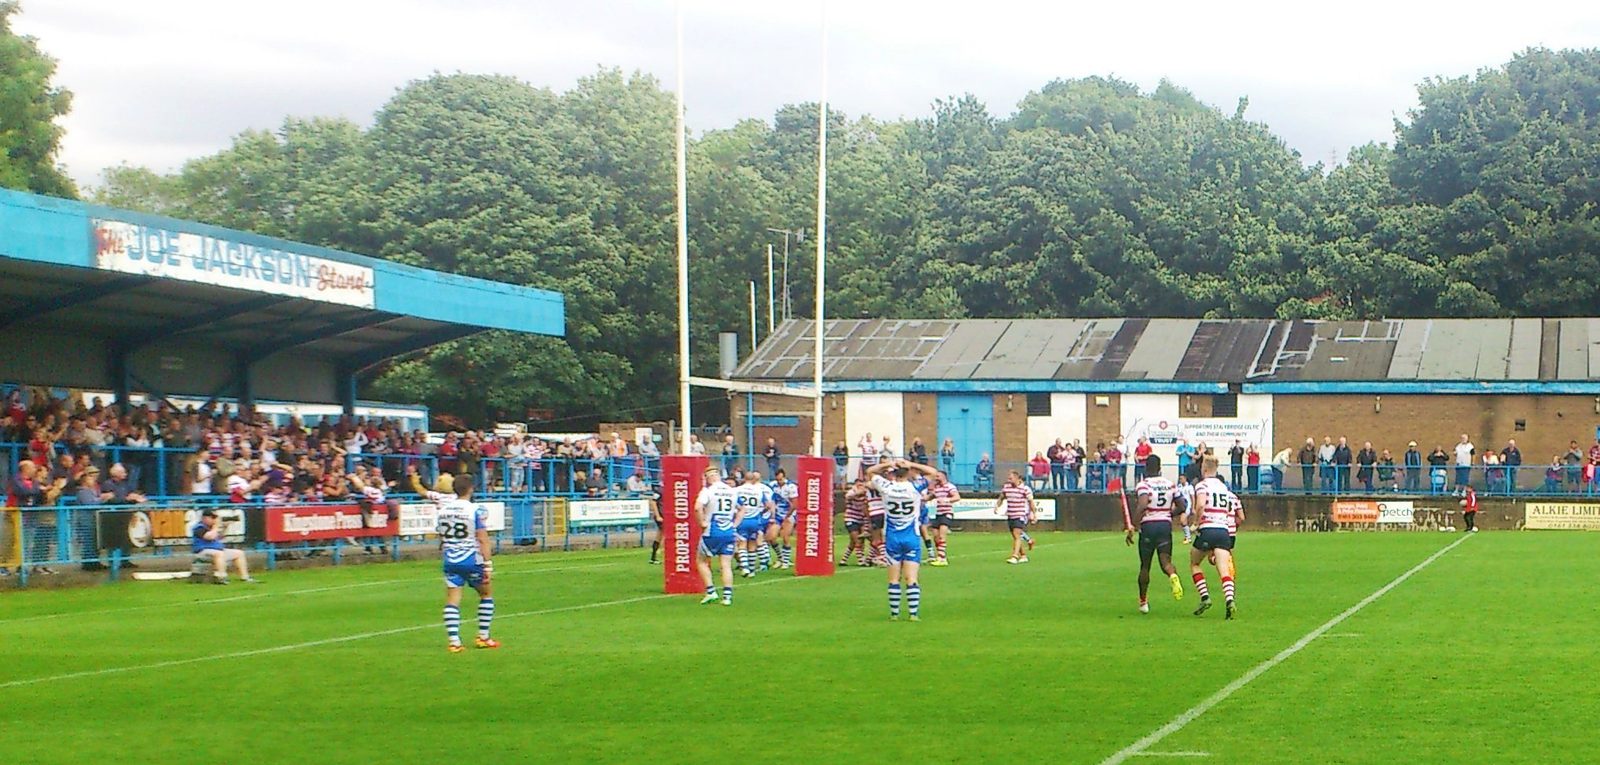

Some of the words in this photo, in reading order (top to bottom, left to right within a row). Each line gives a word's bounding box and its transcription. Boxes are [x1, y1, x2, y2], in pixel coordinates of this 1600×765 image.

[127, 225, 181, 267] JOE
[192, 236, 311, 289] JACKSON
[317, 264, 364, 294] Stand
[674, 479, 689, 519] CIDER
[807, 477, 820, 512] CIDER
[1157, 492, 1167, 507] 5
[1212, 492, 1228, 508] 15
[717, 498, 733, 512] 13
[887, 501, 914, 515] 25
[1532, 505, 1569, 515] ALKIE
[440, 522, 469, 539] 28
[805, 513, 819, 557] PROPER
[675, 522, 691, 573] PROPER
